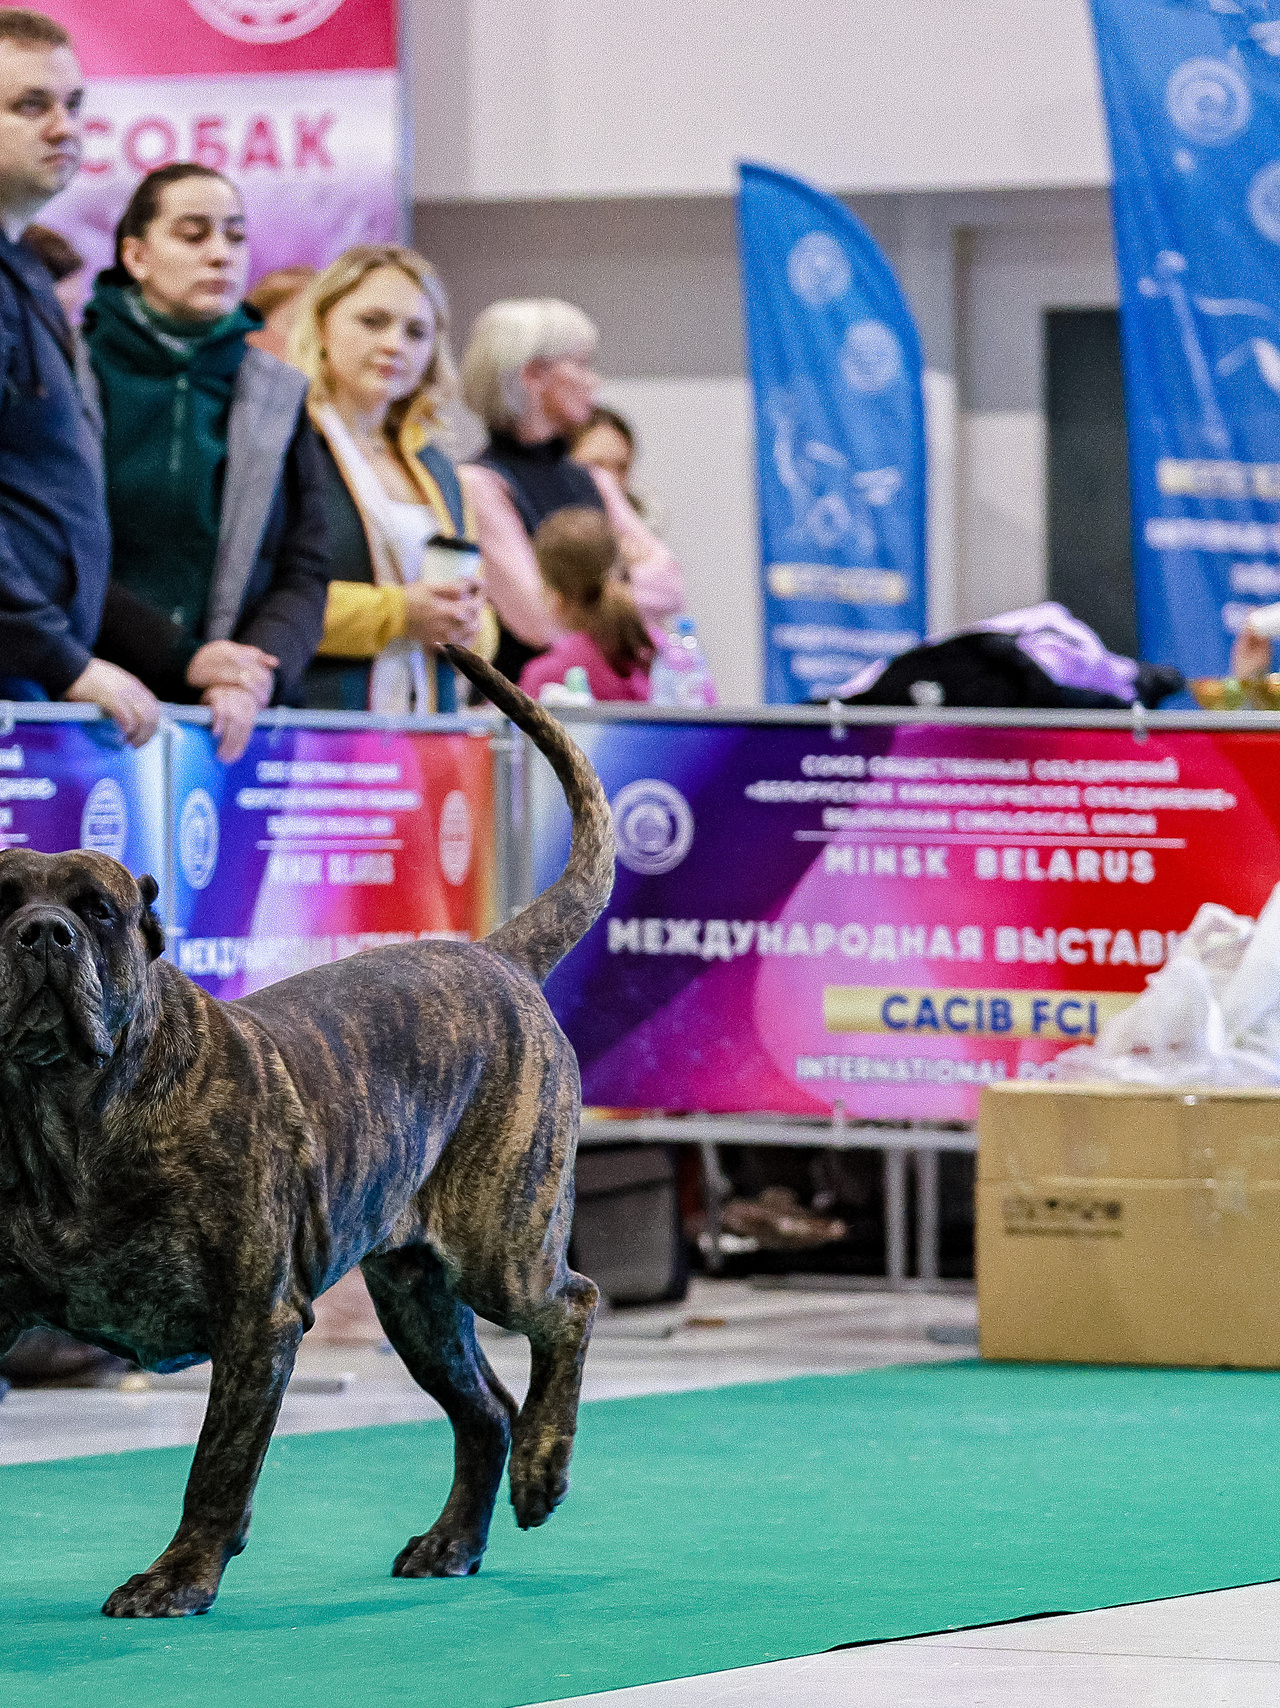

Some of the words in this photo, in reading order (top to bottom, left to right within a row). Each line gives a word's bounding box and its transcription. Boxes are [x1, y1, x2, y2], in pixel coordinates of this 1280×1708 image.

[823, 845, 948, 879] MINSK
[975, 847, 1155, 884] BELARUS
[608, 917, 983, 962] МЕЖДУНАРОДНАЯ
[880, 993, 1014, 1033] CACIB
[1030, 998, 1099, 1035] FCI
